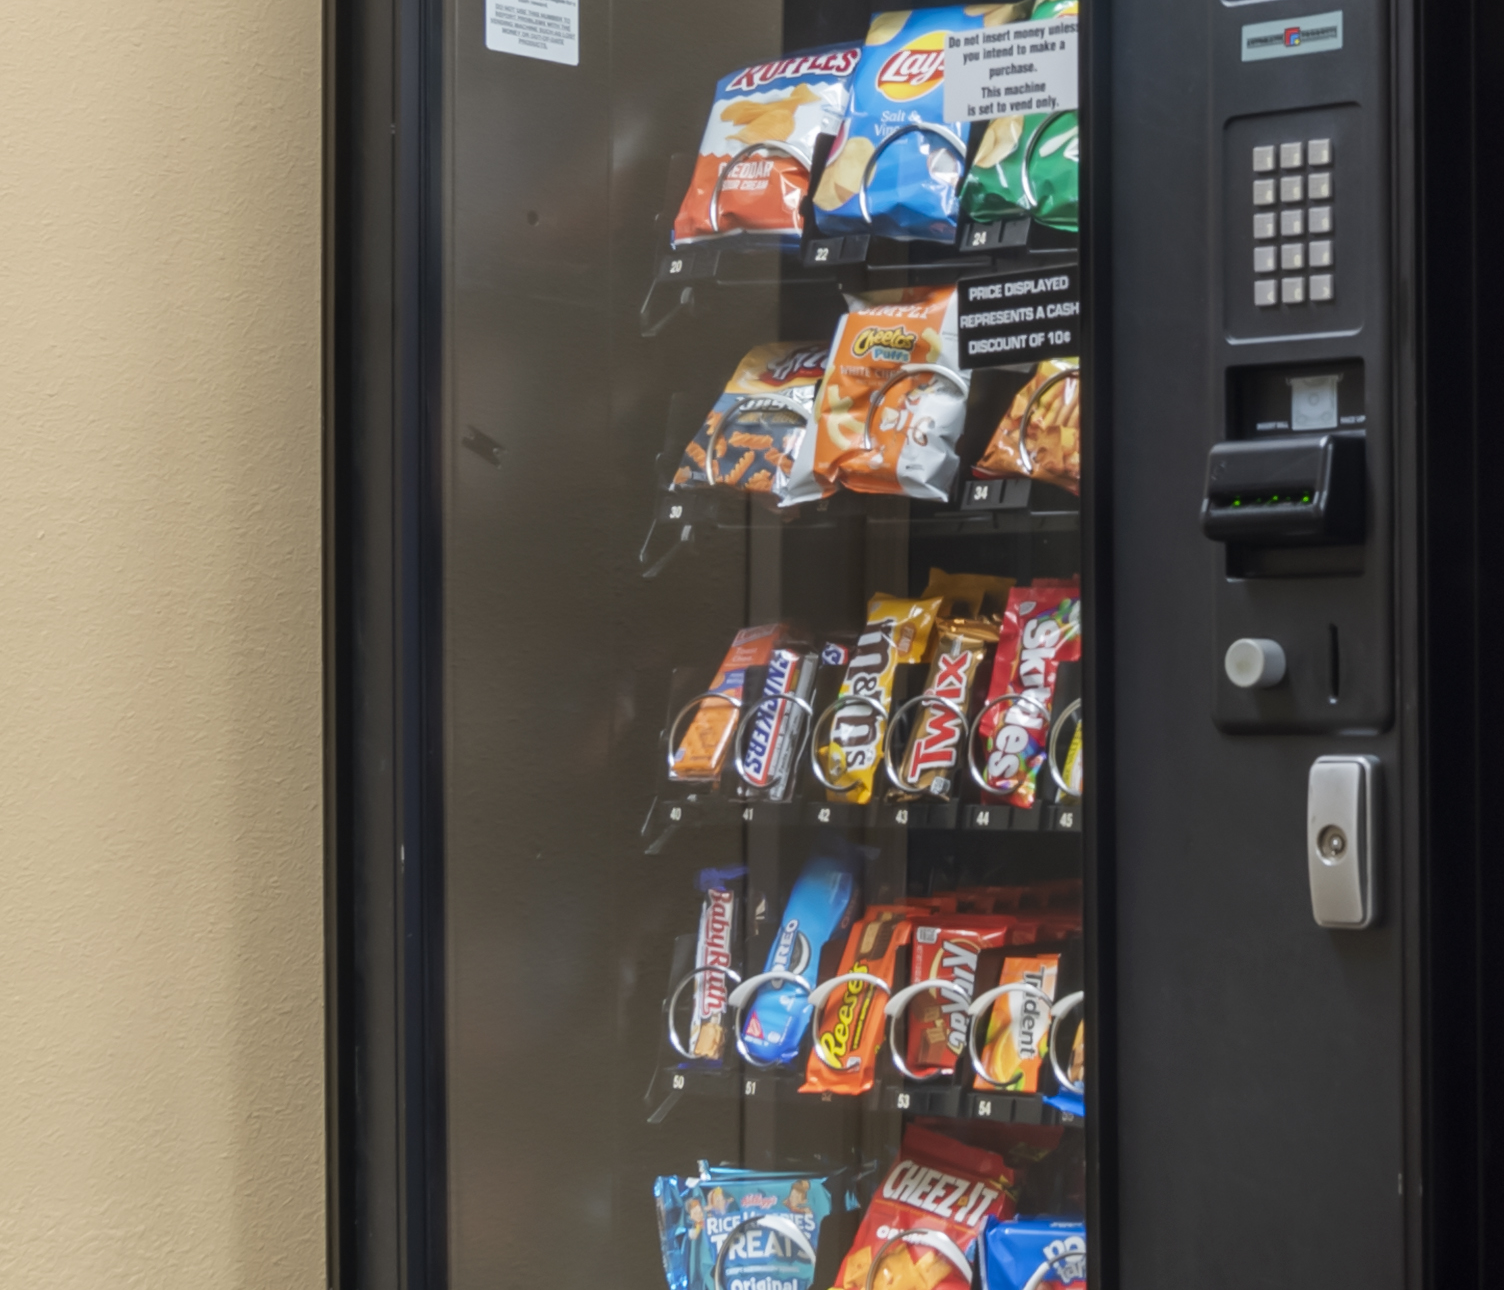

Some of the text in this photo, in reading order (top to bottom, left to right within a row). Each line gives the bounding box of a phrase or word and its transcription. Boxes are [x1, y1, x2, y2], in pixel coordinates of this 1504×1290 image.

[948, 26, 1045, 49] Do not insert money
[963, 40, 1066, 65] you intend to make a
[730, 49, 858, 90] RUFFLES
[989, 61, 1038, 79] purchase.
[981, 82, 1046, 99] This machine
[968, 95, 1060, 117] is set to vend only.
[881, 110, 906, 122] Salt
[972, 232, 987, 245] 24
[815, 248, 829, 261] 22
[670, 261, 683, 273] 20
[968, 276, 1069, 302] PRICE DISPLAYED
[960, 301, 1080, 329] REPRESENTS A CASH
[853, 327, 915, 356] Cheetos
[968, 330, 1071, 355] DISCOUNT OF 10¢
[974, 486, 988, 500] 34
[670, 506, 683, 519] 30
[746, 649, 792, 775] SNICKERS
[742, 809, 754, 821] 41
[817, 808, 831, 822] 42
[895, 810, 908, 824] 43
[976, 811, 990, 825] 44
[1059, 813, 1074, 827] 45
[673, 1075, 684, 1090] 50
[745, 1082, 756, 1095] 51
[897, 1093, 910, 1108] 53
[707, 1213, 733, 1233] RICE
